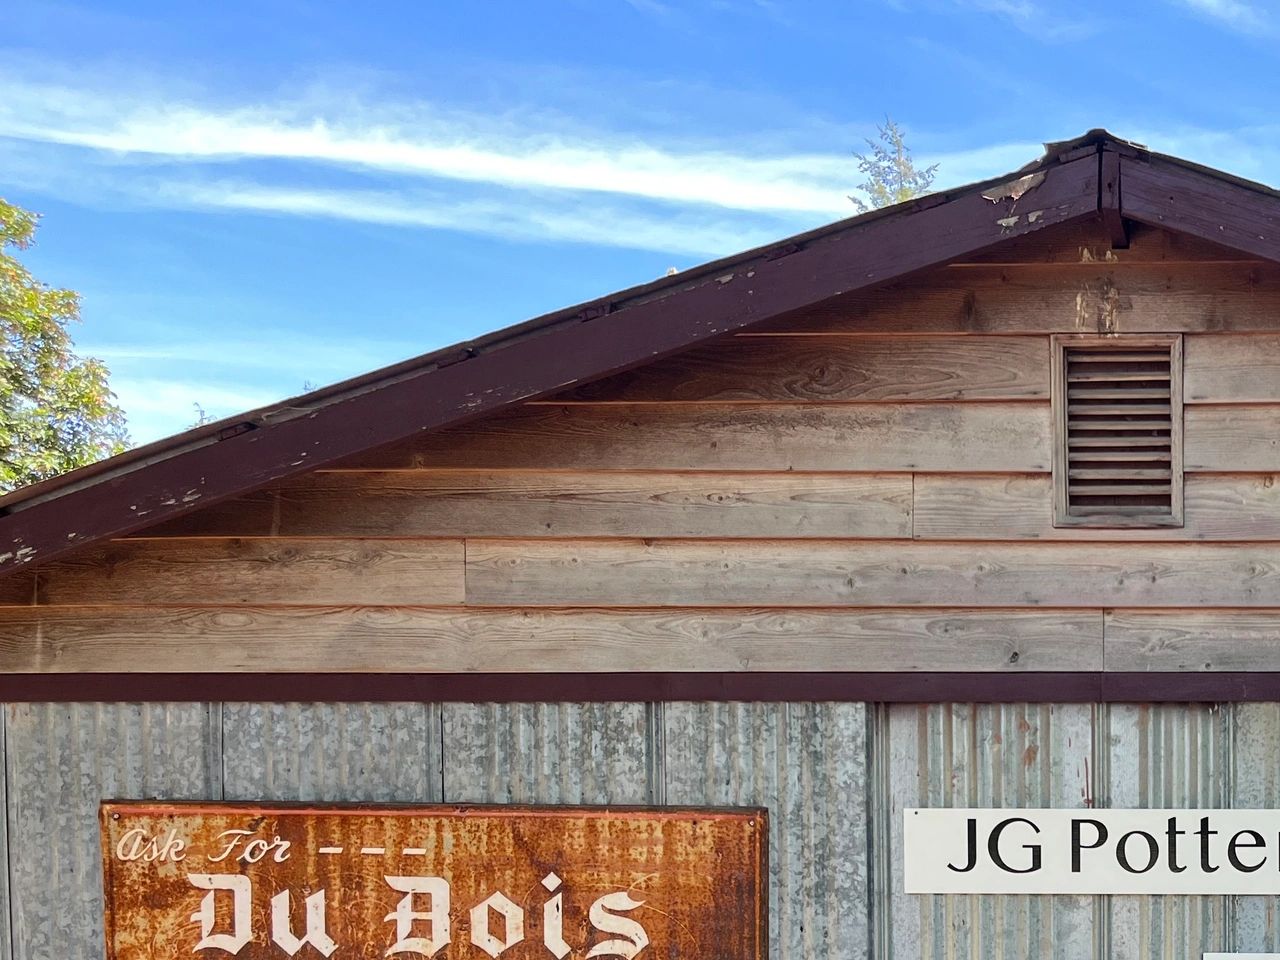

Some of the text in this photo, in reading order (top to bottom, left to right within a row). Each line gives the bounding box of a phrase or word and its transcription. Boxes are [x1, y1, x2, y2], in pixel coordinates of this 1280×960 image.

[115, 828, 292, 864] Ask For
[947, 817, 1043, 875] JG
[187, 871, 340, 959] Du
